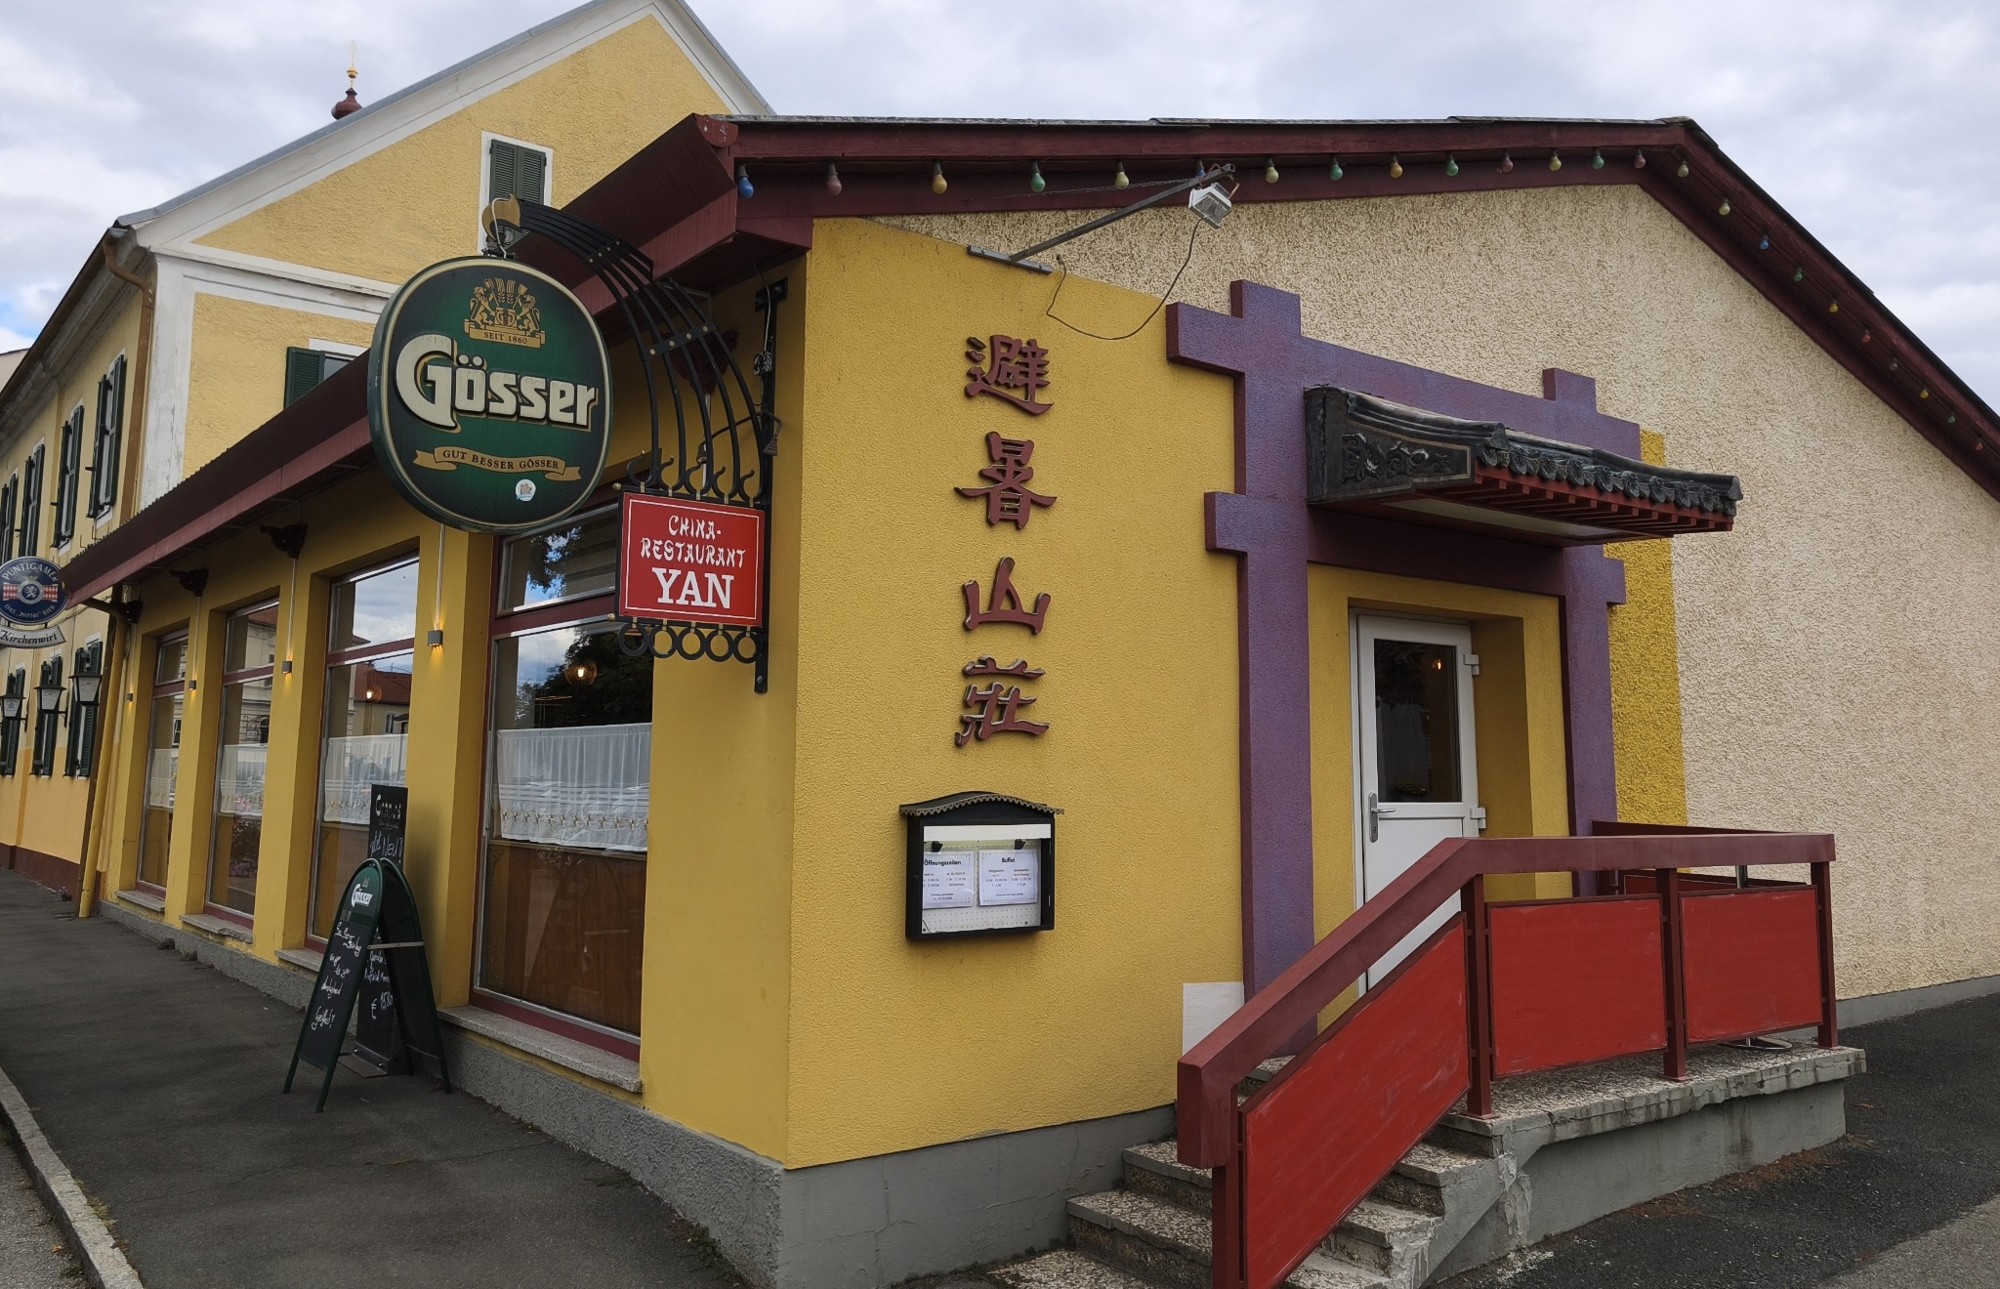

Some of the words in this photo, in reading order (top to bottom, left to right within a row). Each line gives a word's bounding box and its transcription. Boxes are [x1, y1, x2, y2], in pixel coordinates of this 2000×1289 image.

[484, 332, 504, 340] SEIT
[508, 336, 528, 344] 1860
[395, 334, 596, 428] Gösser
[443, 449, 468, 461] GUT
[471, 455, 515, 470] BESSER
[519, 457, 559, 470] GÖSSER
[668, 514, 722, 540] CHINA-
[954, 334, 1058, 748] 避暑山莊
[640, 537, 746, 569] RESTAURANT
[651, 567, 735, 609] YAN
[0, 630, 58, 645] Kirchenwirt
